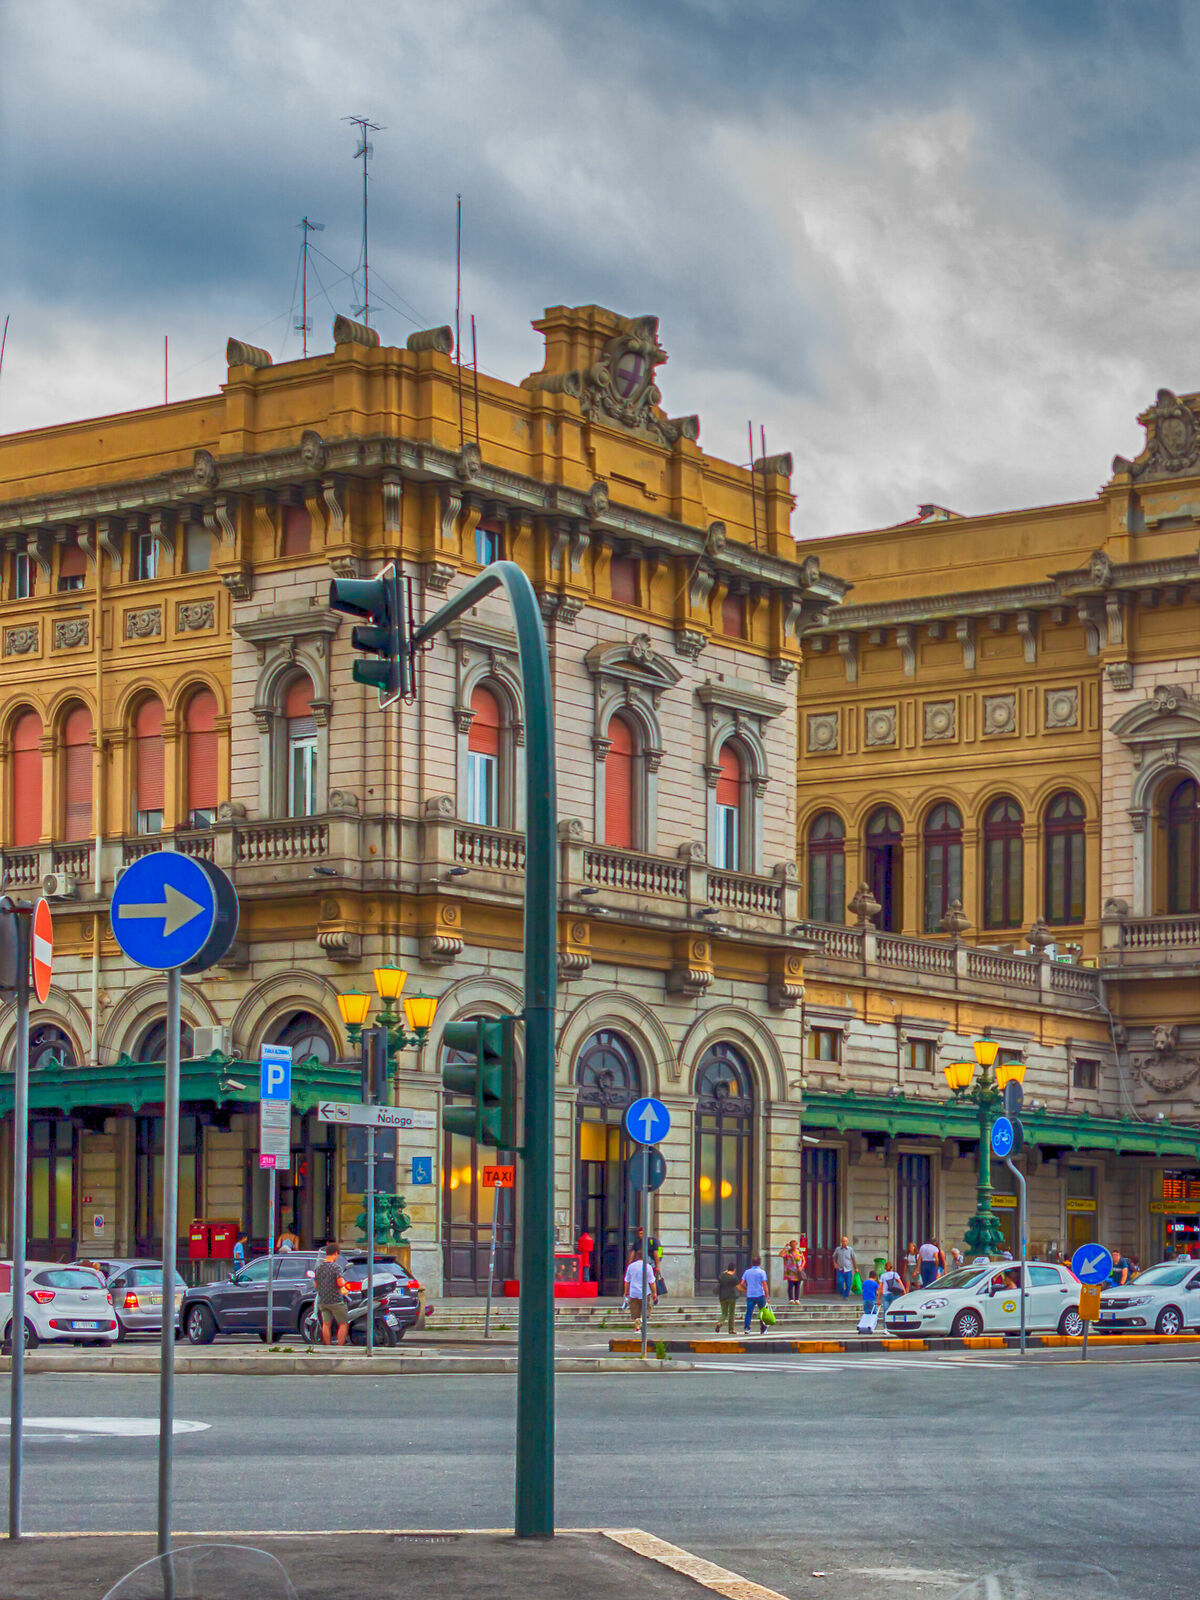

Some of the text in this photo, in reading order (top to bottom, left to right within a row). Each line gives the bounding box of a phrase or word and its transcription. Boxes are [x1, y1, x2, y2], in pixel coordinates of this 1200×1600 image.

[267, 1064, 286, 1095] P
[377, 1113, 412, 1127] Nologo
[485, 1171, 513, 1182] TAXI
